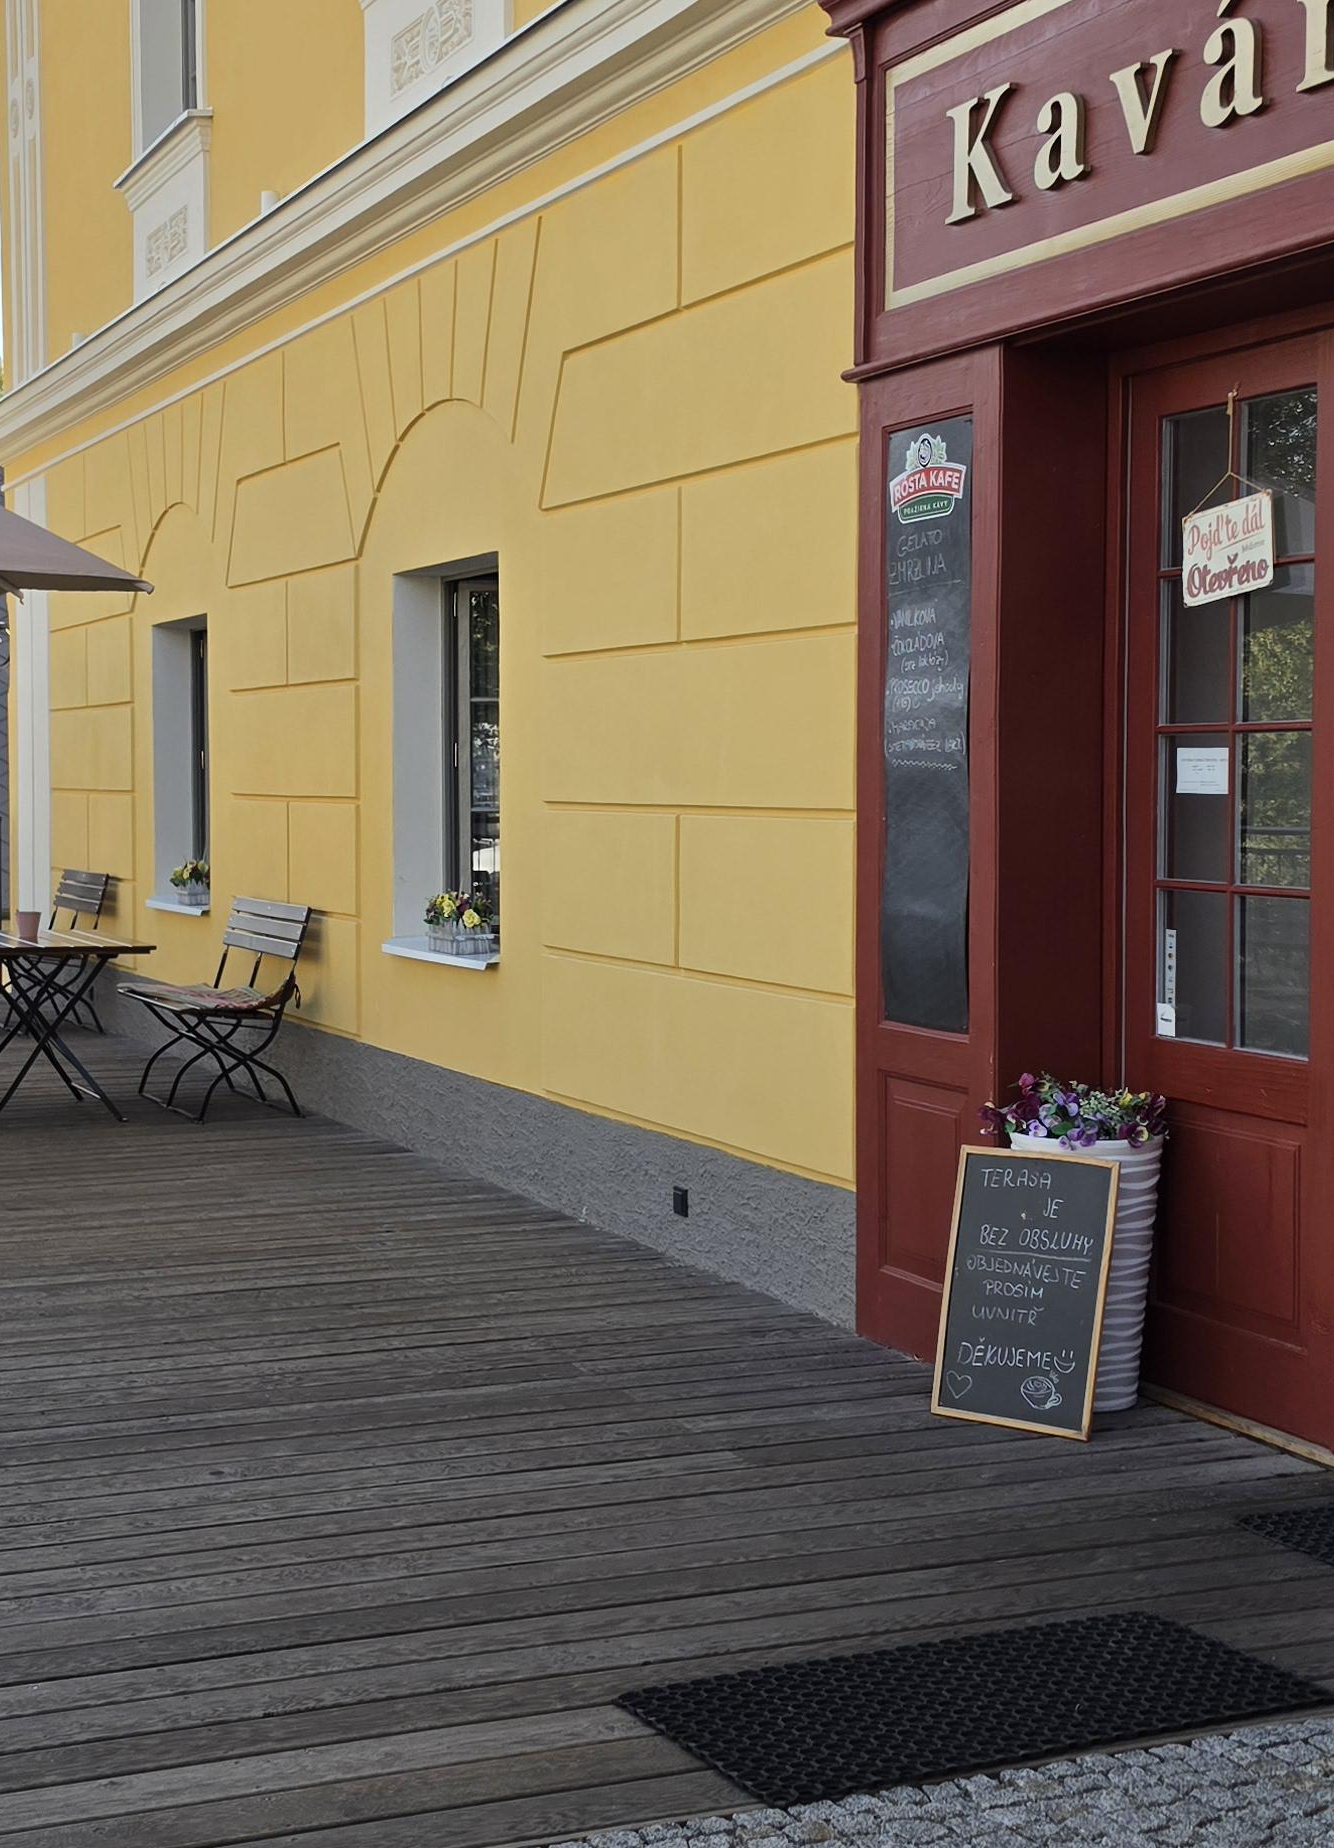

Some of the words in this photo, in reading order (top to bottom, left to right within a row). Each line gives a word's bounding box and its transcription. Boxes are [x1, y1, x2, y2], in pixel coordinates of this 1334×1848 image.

[893, 472, 927, 502] ROSTA
[929, 470, 960, 489] KAFE
[897, 529, 943, 557] GELATO
[1188, 514, 1238, 561] Pojďte
[1242, 501, 1265, 536] dál
[1187, 553, 1269, 598] Otevřeno
[980, 1168, 1052, 1190] TERASA
[1042, 1197, 1064, 1219] JE
[979, 1223, 1008, 1247] BEZ
[1018, 1228, 1095, 1255] OBSLUHY
[967, 1254, 1087, 1290] OBJEDNÁVEJTE
[971, 1305, 1045, 1326] UVNITŘ
[956, 1336, 1053, 1371] DĚKUJEME
